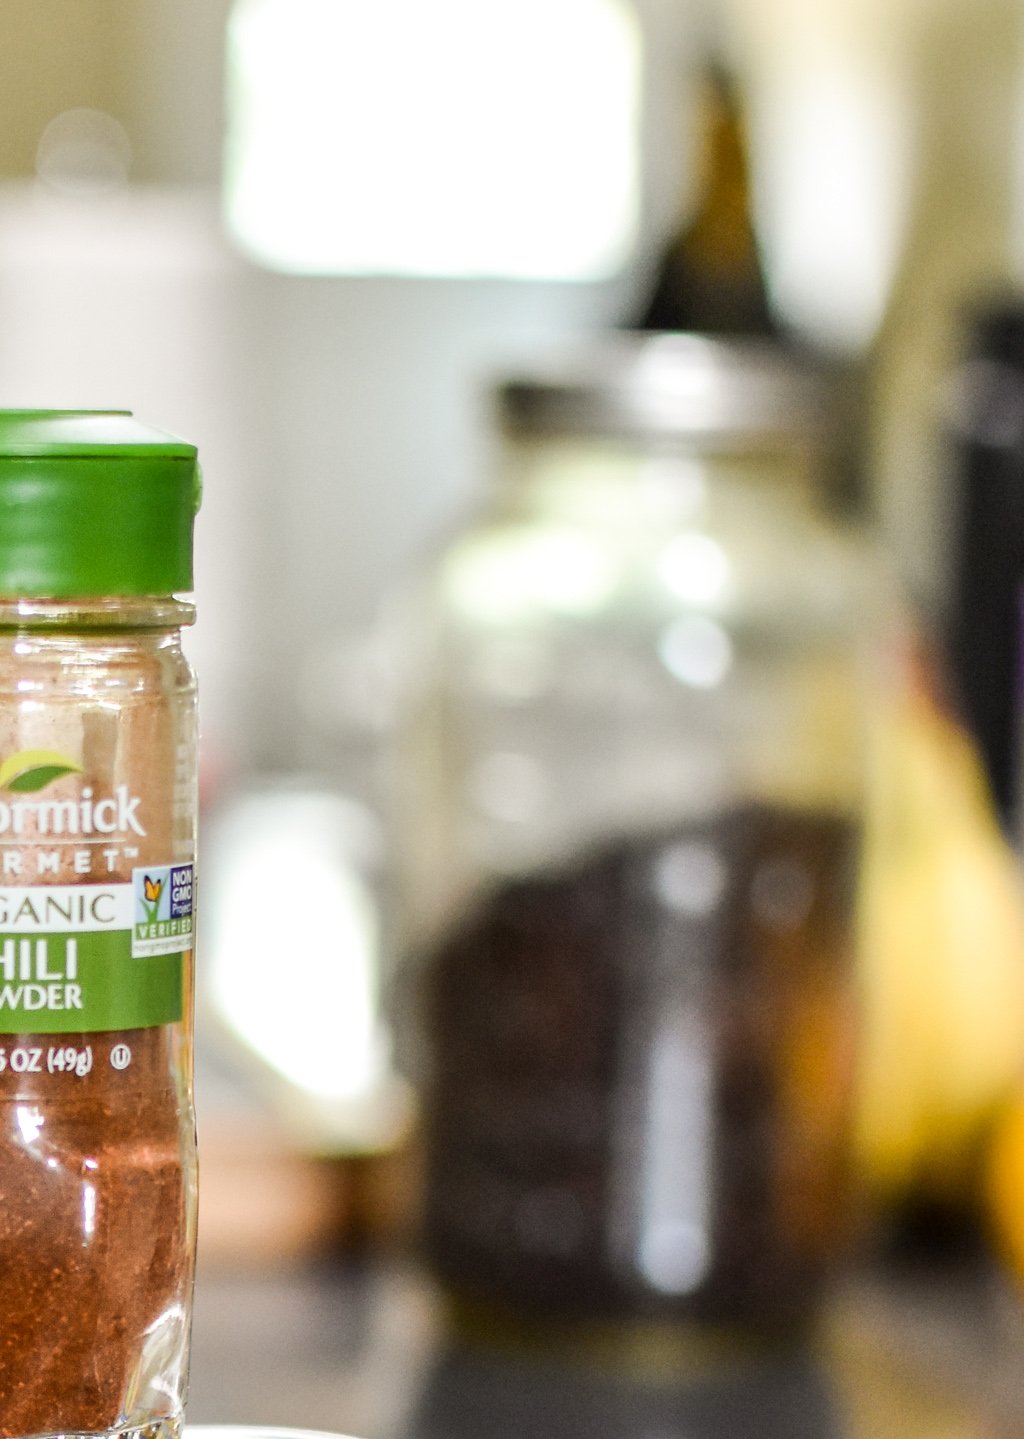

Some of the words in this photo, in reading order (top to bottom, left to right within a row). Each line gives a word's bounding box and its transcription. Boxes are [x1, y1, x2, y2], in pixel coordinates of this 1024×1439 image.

[173, 870, 192, 886] NON
[172, 886, 192, 902] GMO
[138, 919, 192, 939] VERIFIED
[10, 1049, 42, 1072] OZ
[47, 1047, 93, 1077] (49g)
